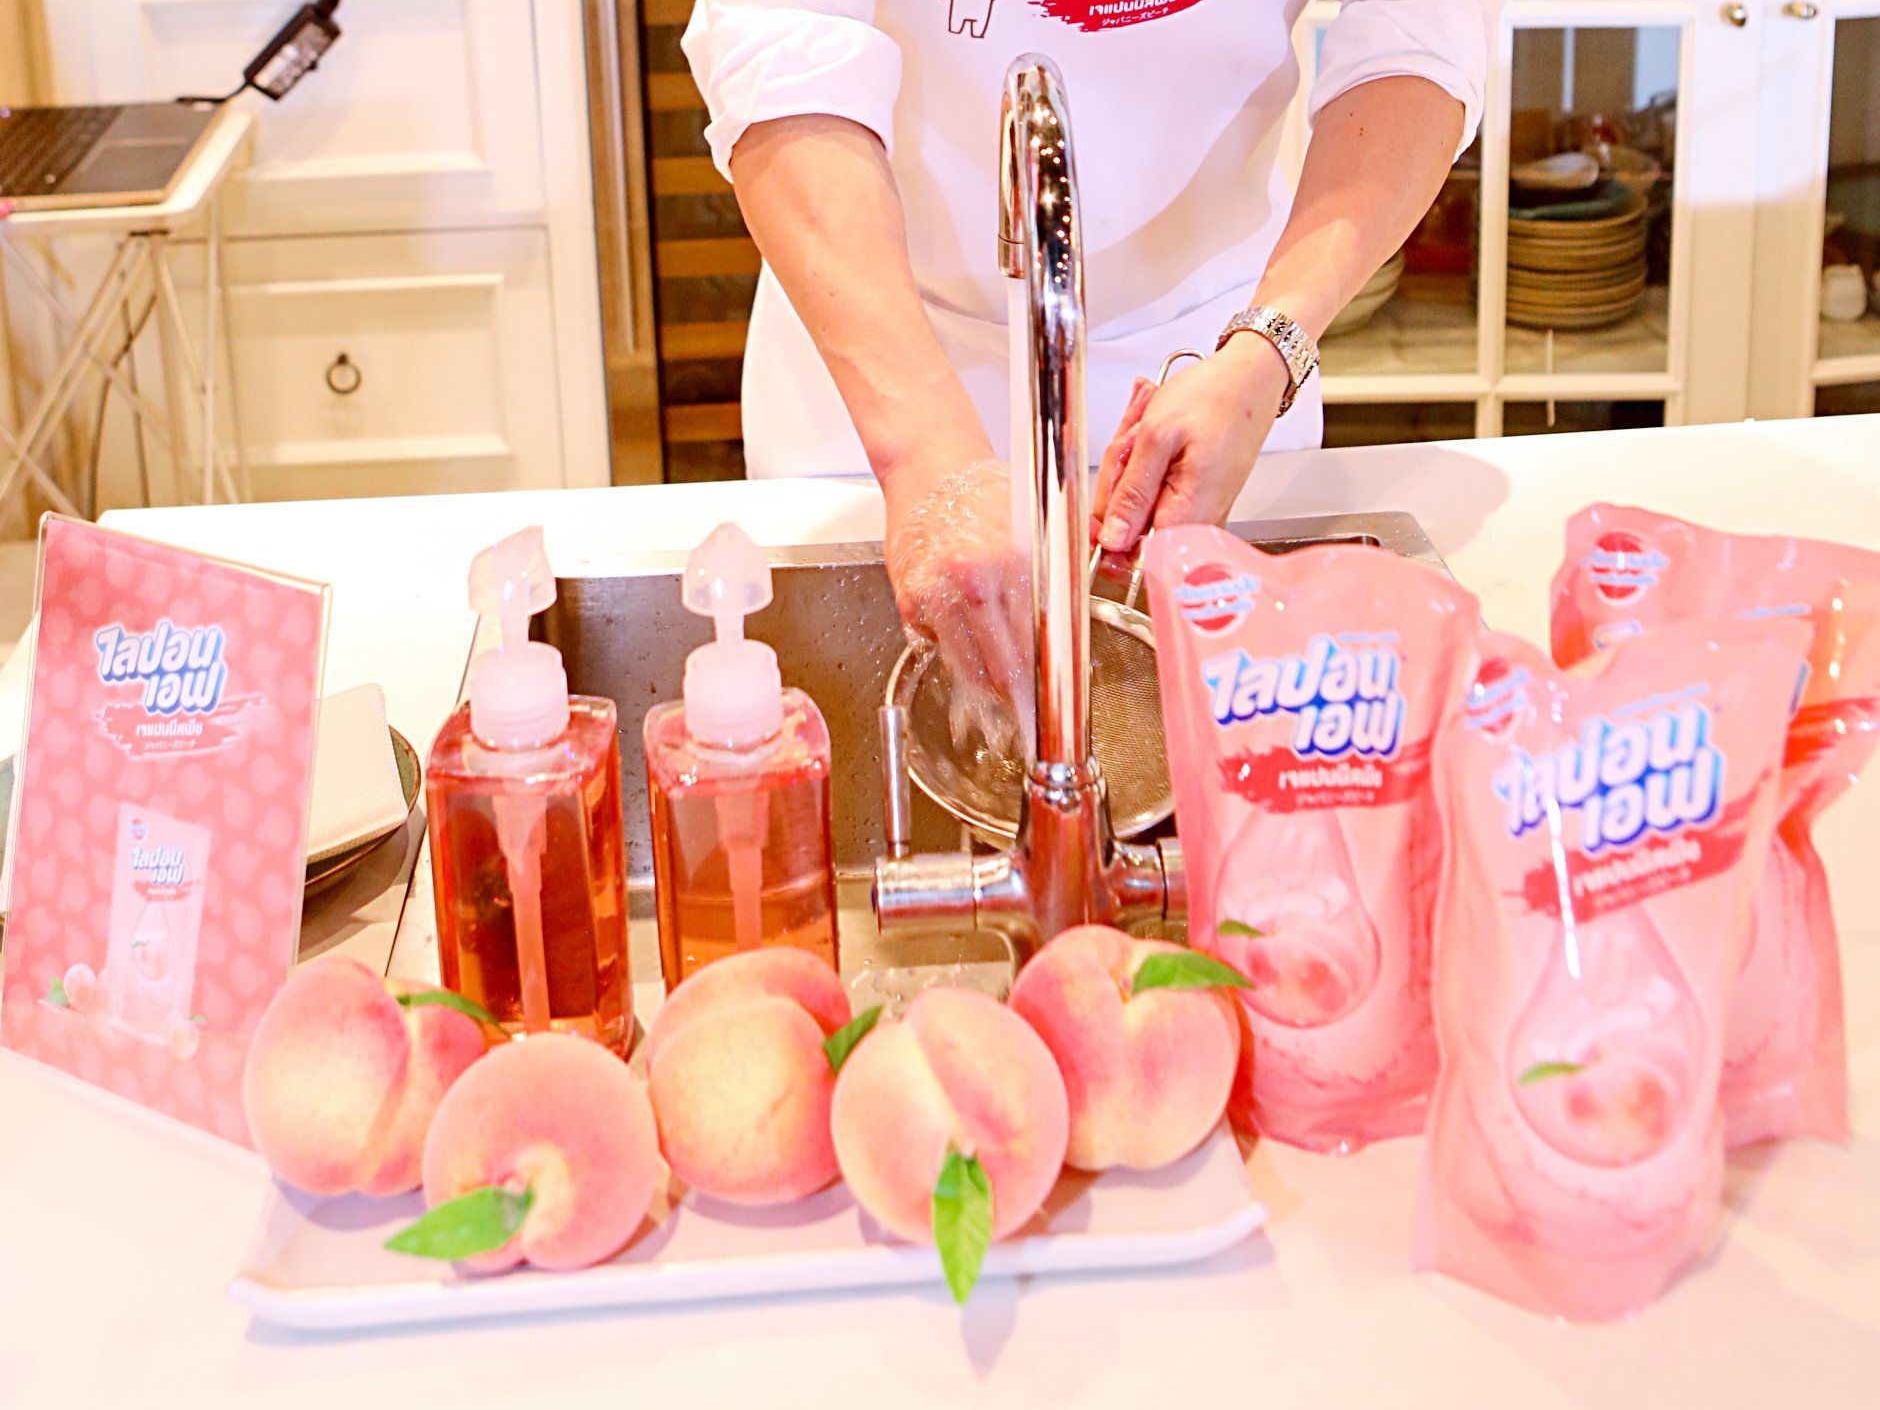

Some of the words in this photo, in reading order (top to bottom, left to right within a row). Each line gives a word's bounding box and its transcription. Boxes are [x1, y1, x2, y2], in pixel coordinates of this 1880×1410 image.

[97, 620, 222, 682] ไลปอน
[1205, 638, 1398, 725] ไลปอน
[145, 659, 226, 714] เอฟ
[1295, 691, 1404, 756] เอฟ
[1583, 745, 1722, 853] เอฟ
